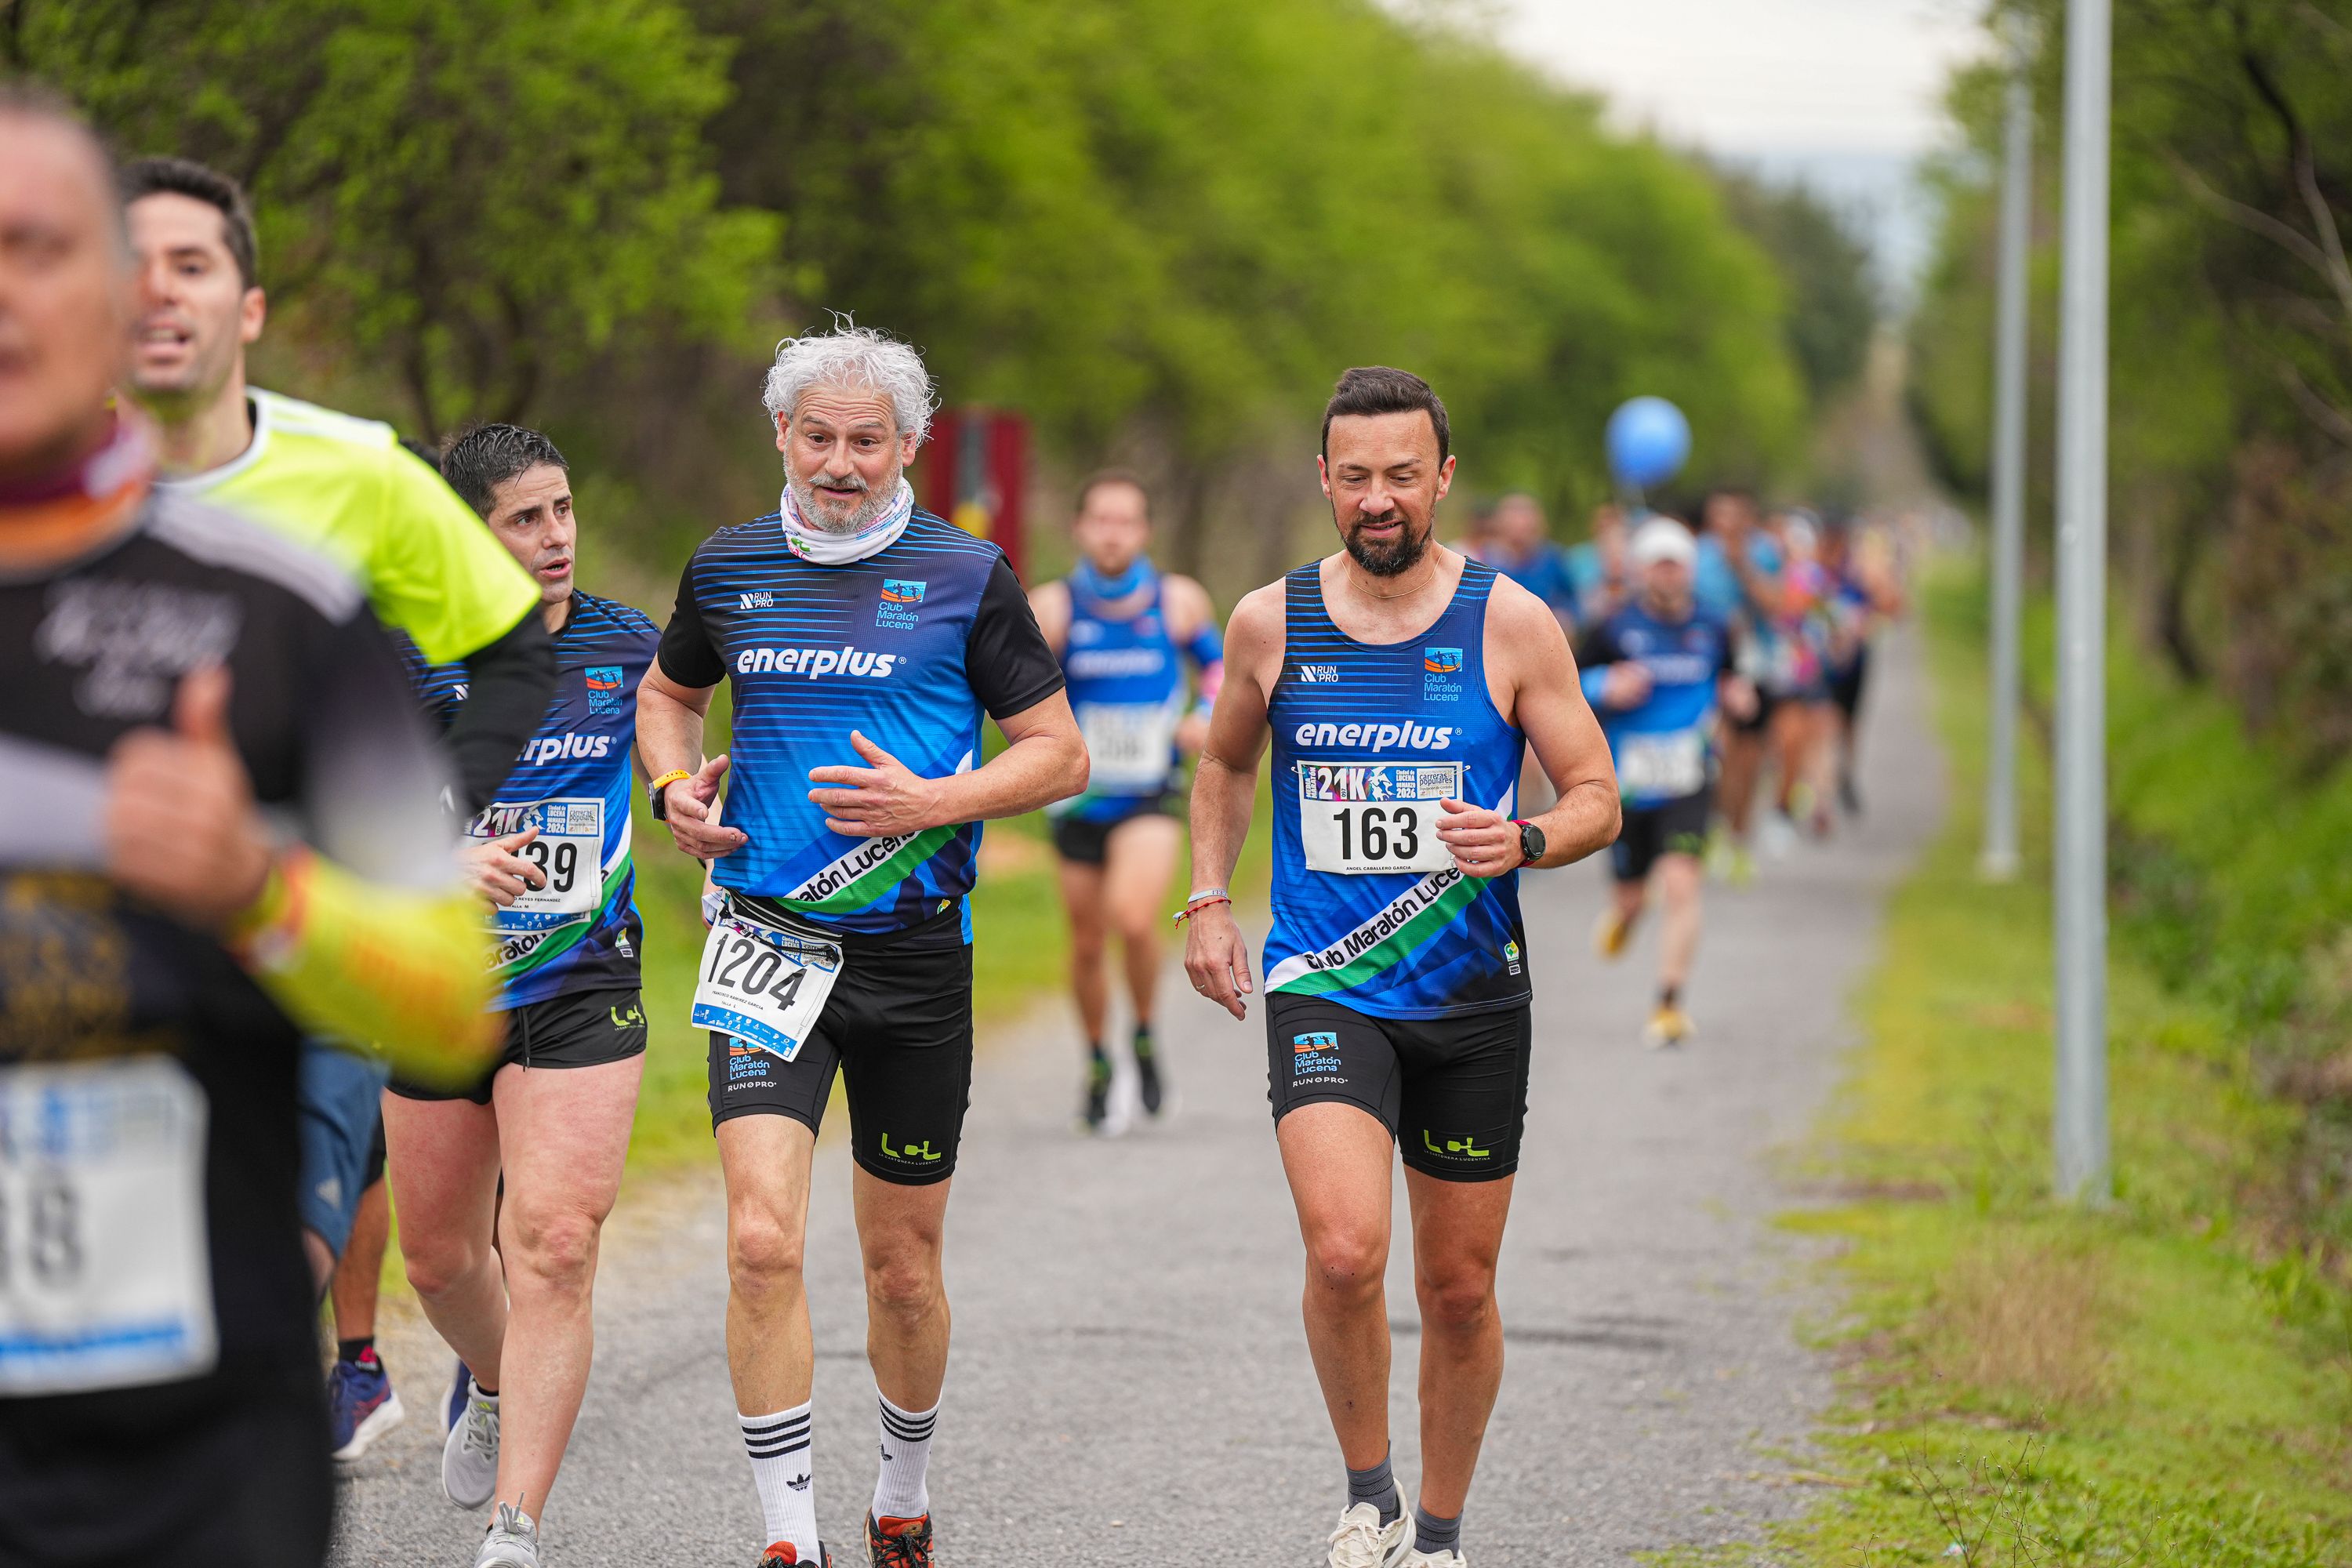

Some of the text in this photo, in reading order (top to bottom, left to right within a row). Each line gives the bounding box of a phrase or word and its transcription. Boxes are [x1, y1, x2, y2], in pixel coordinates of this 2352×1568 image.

[754, 591, 771, 600] RUN
[755, 599, 774, 608] PRO
[878, 601, 903, 612] Club
[877, 609, 919, 622] Maratón
[876, 619, 914, 630] Lucena
[737, 646, 897, 680] enerplus
[1317, 666, 1337, 674] RUN
[1319, 673, 1339, 682] PRO
[1425, 673, 1446, 683] Club
[1424, 682, 1462, 692] Maratón
[588, 690, 610, 699] Club
[1424, 691, 1459, 701] Lucena
[1295, 720, 1453, 753] enerplus
[514, 732, 610, 766] rplus
[1317, 767, 1367, 800] 21K
[1419, 777, 1453, 786] populares
[1396, 787, 1416, 798] 2026
[546, 822, 565, 833] 2026
[1334, 807, 1418, 861] 163
[1304, 867, 1461, 969] Club Maratón Luce
[707, 933, 808, 1011] 1204
[748, 1001, 764, 1010] GARCIA
[729, 1054, 751, 1065] Club
[1294, 1051, 1319, 1061] Club
[1295, 1056, 1341, 1067] Maratón
[730, 1060, 770, 1073] Maratón
[1295, 1065, 1338, 1076] Lucena
[730, 1069, 767, 1080] Lucena
[728, 1083, 746, 1091] RUN
[1293, 1078, 1313, 1087] RUN
